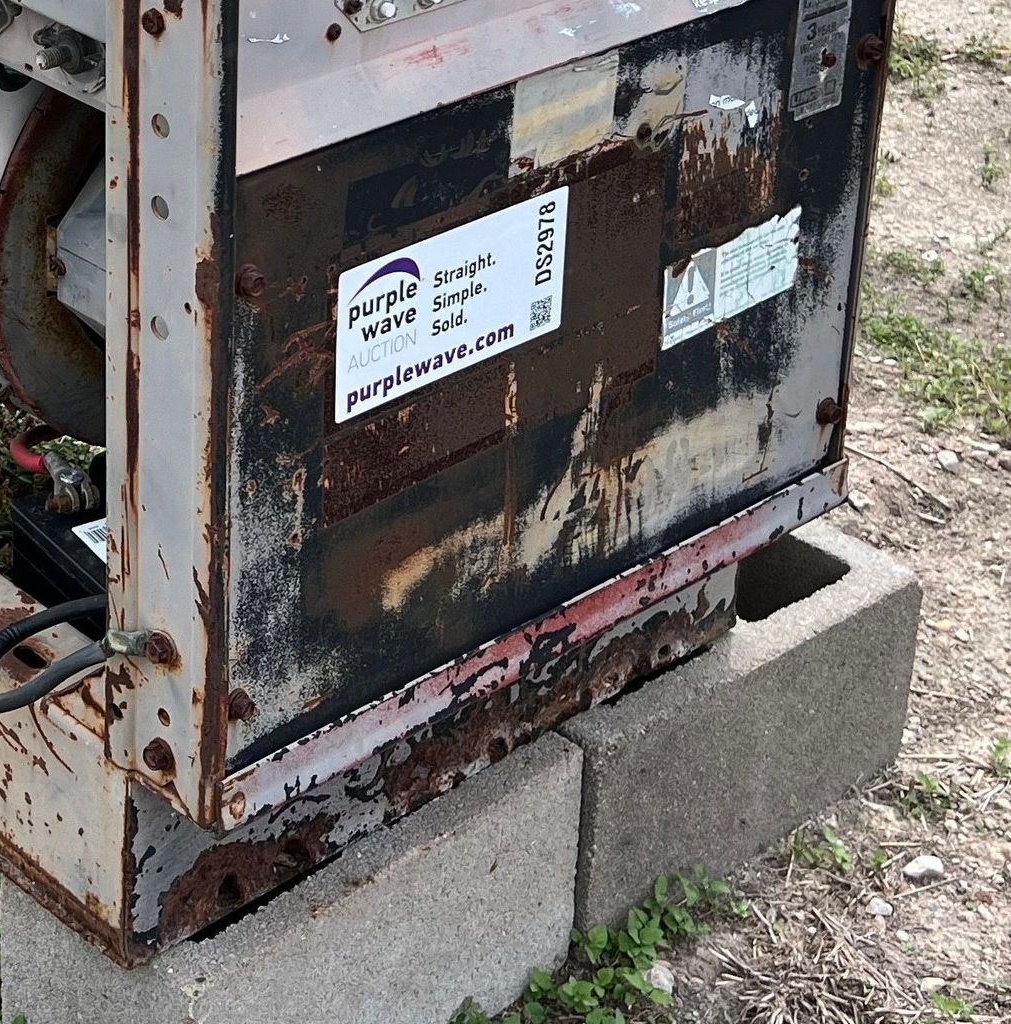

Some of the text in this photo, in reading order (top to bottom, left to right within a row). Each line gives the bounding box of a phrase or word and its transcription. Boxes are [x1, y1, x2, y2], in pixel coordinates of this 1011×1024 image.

[535, 200, 556, 286] DS2978
[433, 252, 496, 288] Straight.
[348, 280, 418, 329] purple
[432, 281, 487, 313] Simple.
[361, 307, 417, 342] wave
[431, 310, 468, 336] Sold.
[346, 323, 514, 413] purplewave.com
[347, 329, 417, 373] AUCTION
